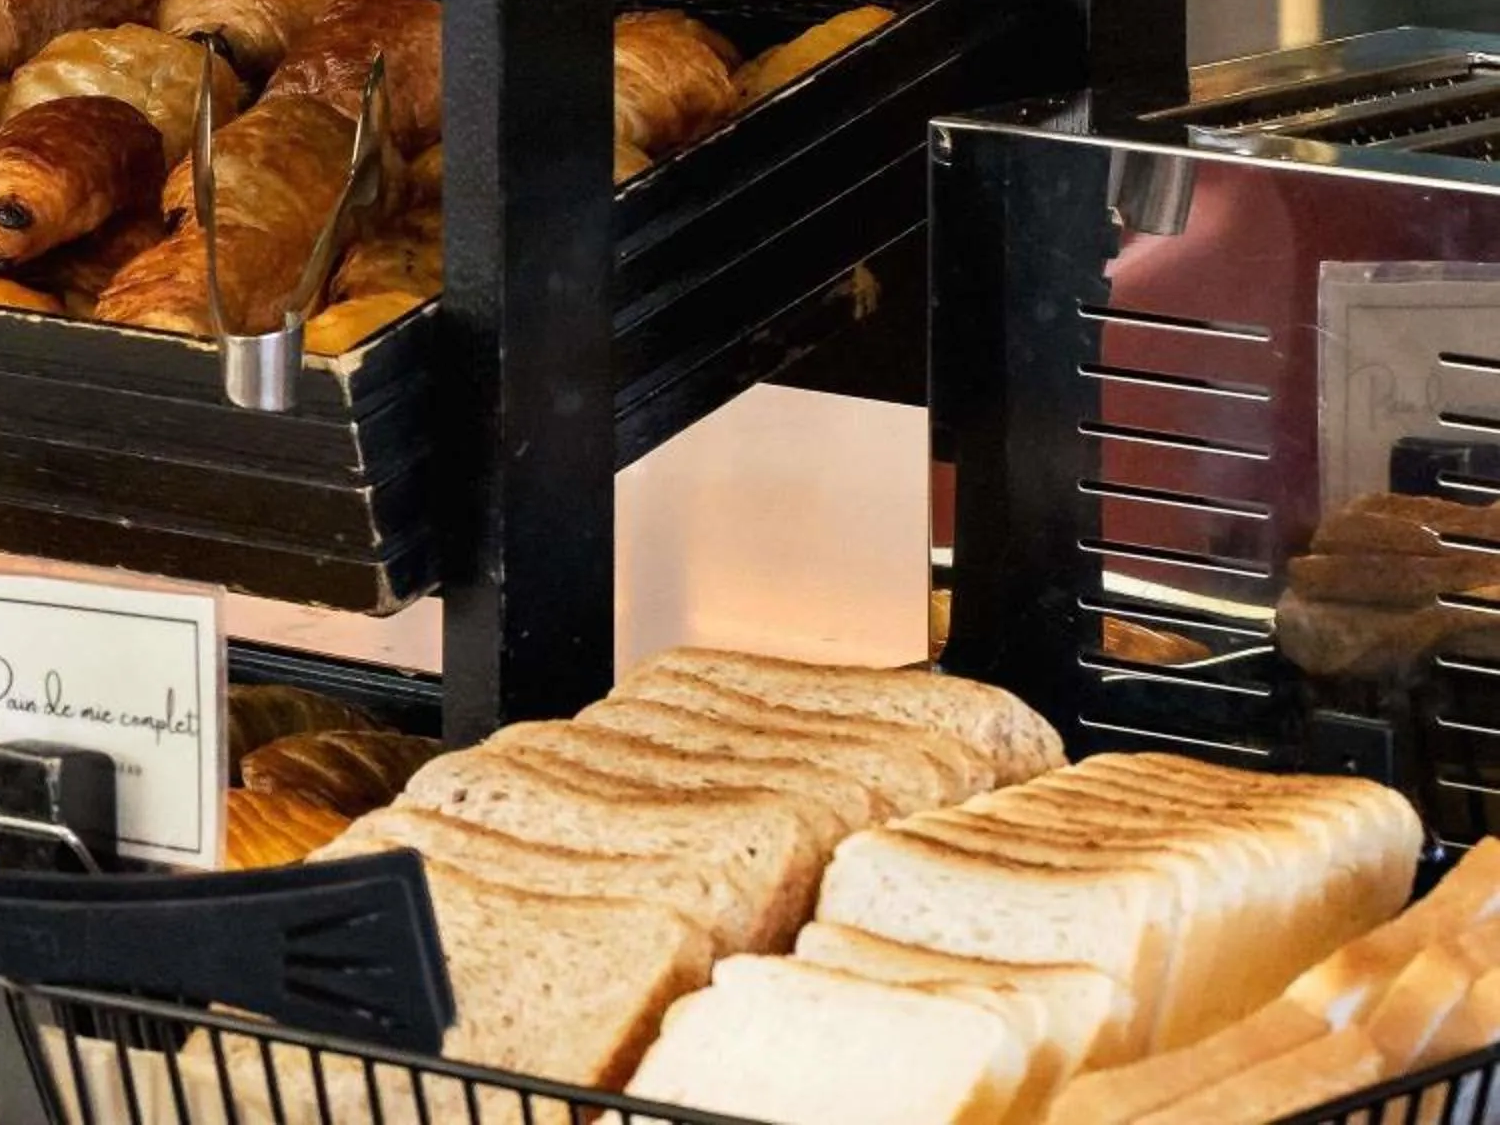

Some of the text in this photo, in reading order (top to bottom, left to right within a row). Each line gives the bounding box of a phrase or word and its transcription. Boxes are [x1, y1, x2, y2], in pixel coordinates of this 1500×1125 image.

[43, 669, 75, 719] de
[80, 706, 115, 725] mie
[119, 686, 199, 748] complet
